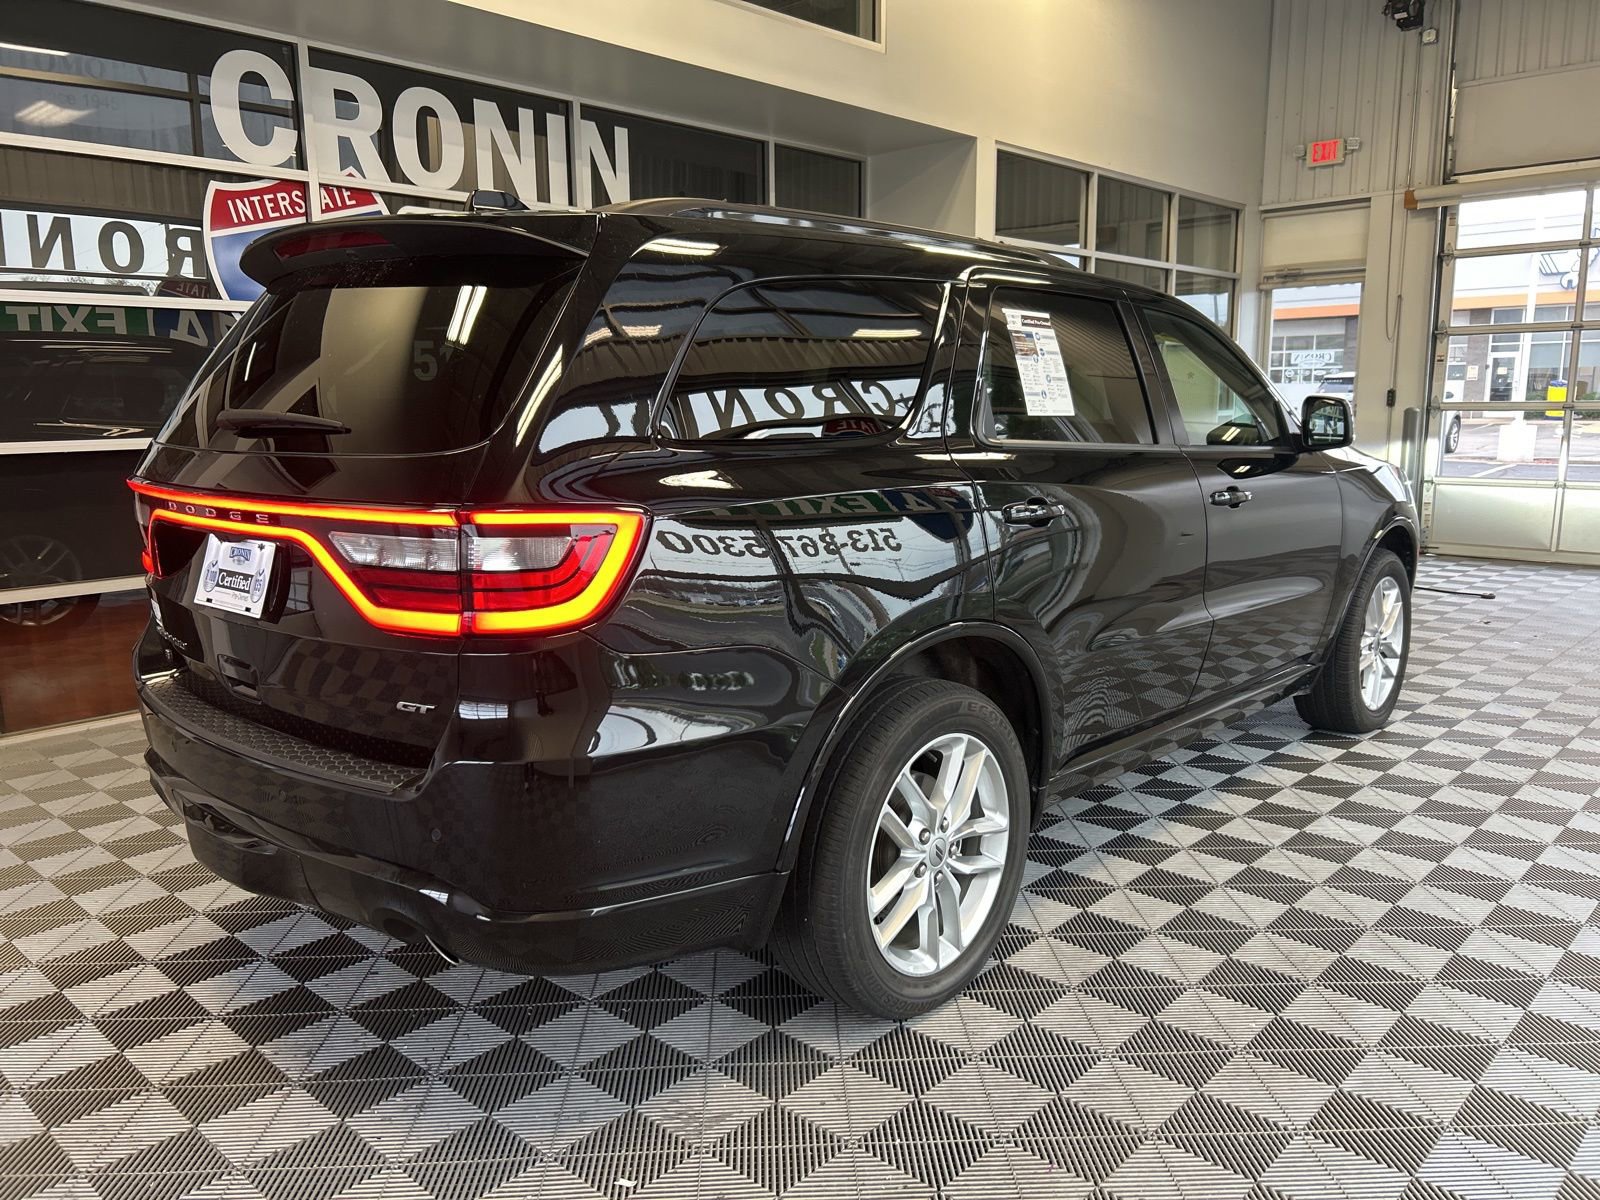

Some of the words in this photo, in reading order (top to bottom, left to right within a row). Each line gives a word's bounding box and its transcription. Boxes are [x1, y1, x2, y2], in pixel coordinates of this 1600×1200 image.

[210, 49, 631, 204] CRONIN
[1311, 141, 1338, 162] EXIT
[227, 187, 357, 224] INTERSATE
[168, 501, 270, 524] DODGE
[218, 571, 251, 592] Certified
[396, 701, 437, 714] GT
